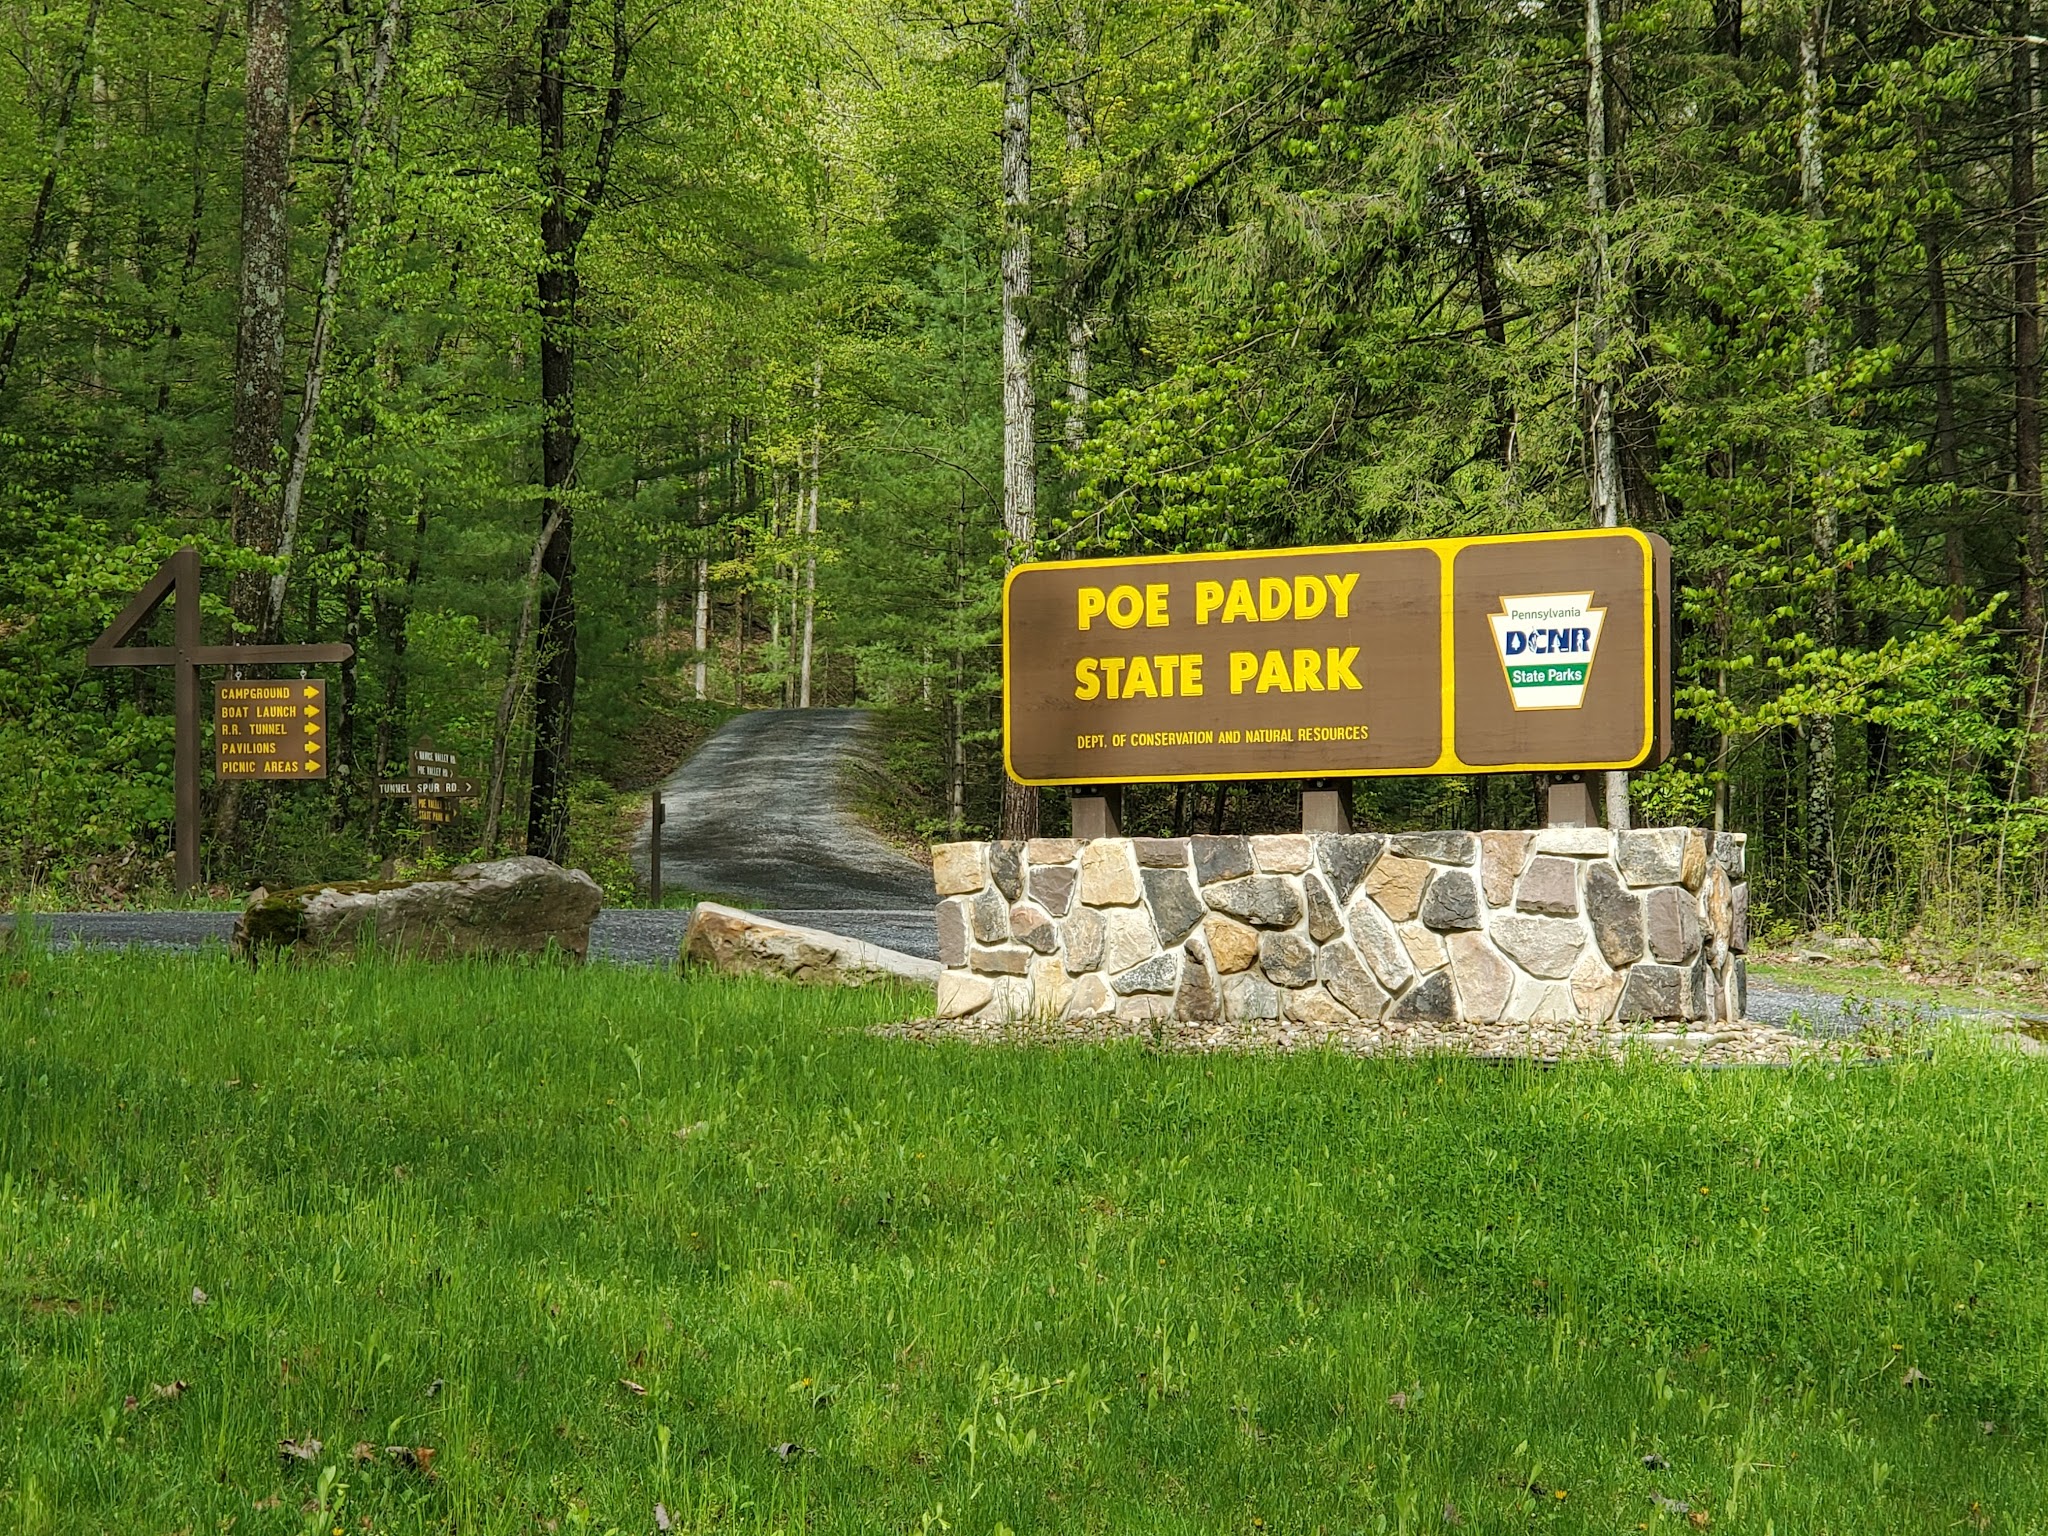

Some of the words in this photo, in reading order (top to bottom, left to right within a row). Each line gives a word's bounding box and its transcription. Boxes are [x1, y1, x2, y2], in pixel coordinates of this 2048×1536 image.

[1078, 584, 1169, 630] POE
[1196, 573, 1360, 625] PADDY
[1511, 607, 1581, 620] Pennsylvania
[1505, 627, 1591, 655] DCNR
[1075, 654, 1203, 700] STATE
[1230, 647, 1362, 694] PARK
[1512, 670, 1545, 683] State
[1548, 668, 1582, 681] Parks
[221, 687, 290, 700] CAMPGROUND
[221, 706, 249, 718] BOAT
[256, 706, 297, 718] LAUNCH
[221, 724, 242, 736] R.R.
[249, 723, 288, 735] TUNNEL
[1077, 735, 1107, 749] DEPT.
[1112, 734, 1127, 747] OF
[1130, 730, 1213, 747] CONSERVATION
[1218, 730, 1241, 744] AND
[1245, 729, 1294, 743] NATURAL
[1298, 725, 1369, 741] RESOURCES
[221, 742, 277, 754] PAVILIONS
[222, 762, 256, 773] PICNIC
[263, 761, 298, 773] AREAS
[379, 783, 412, 794] TUNNEL
[417, 783, 440, 793] SPUR
[445, 783, 461, 792] RD.
